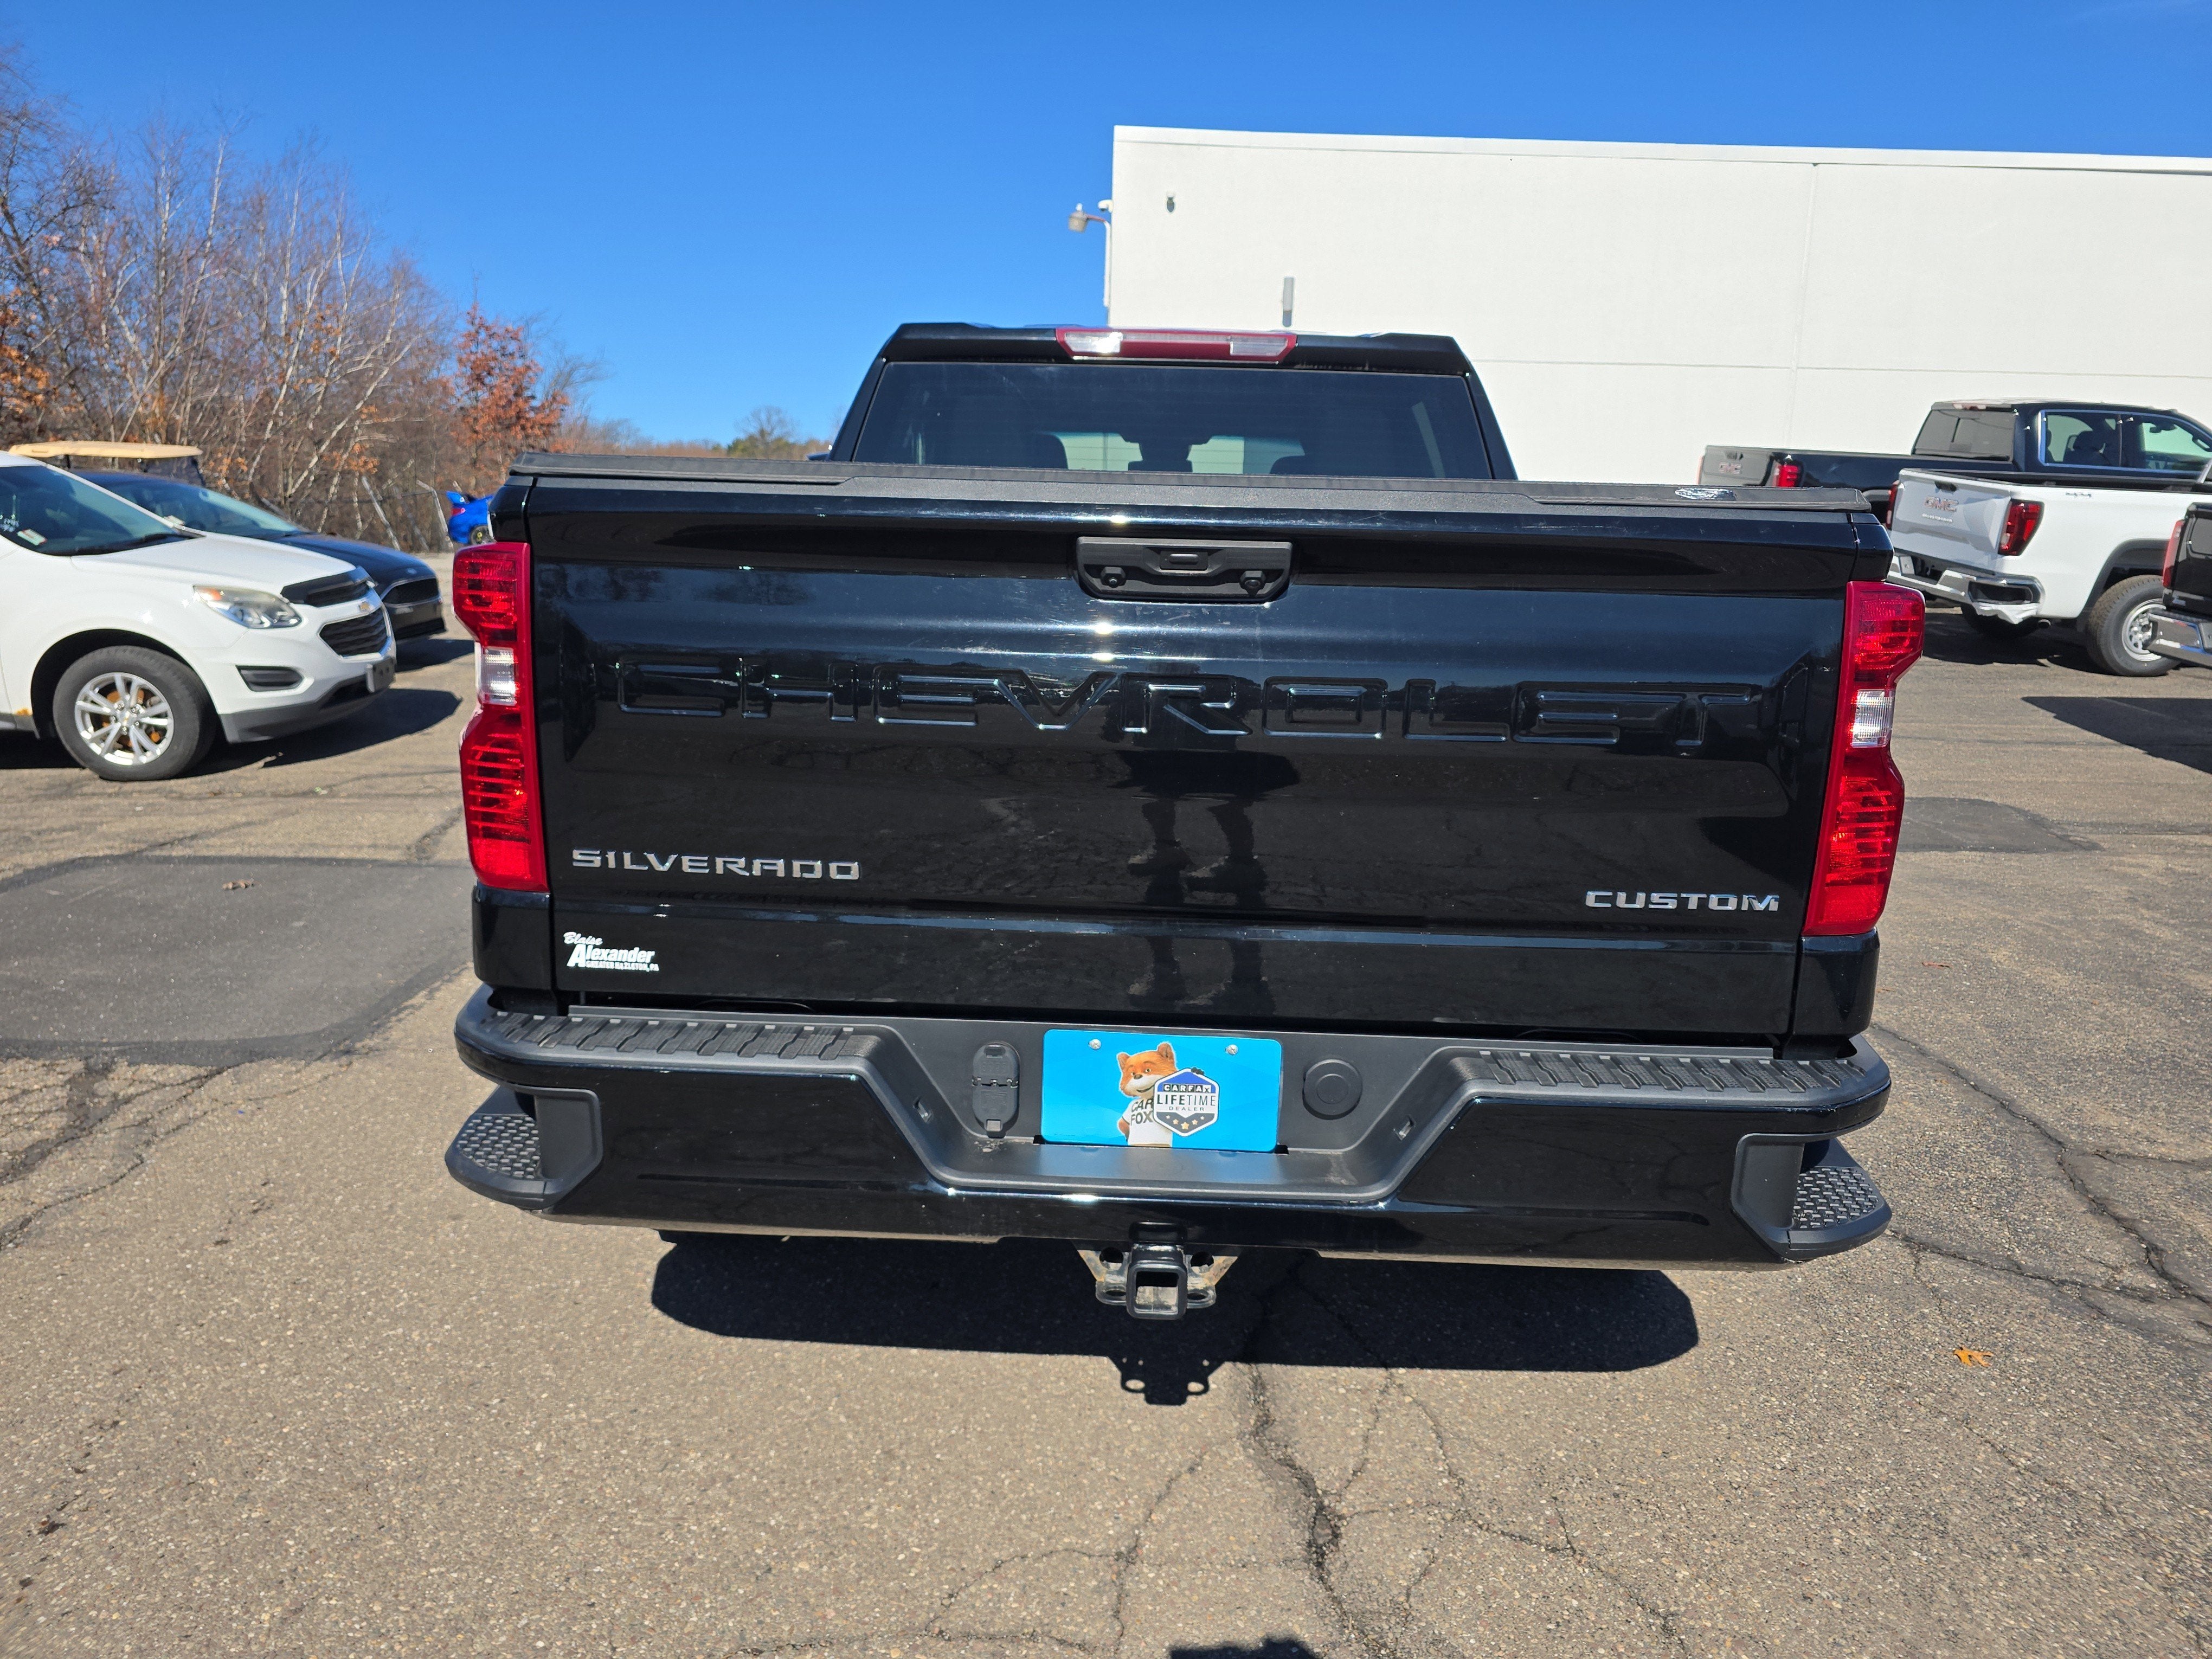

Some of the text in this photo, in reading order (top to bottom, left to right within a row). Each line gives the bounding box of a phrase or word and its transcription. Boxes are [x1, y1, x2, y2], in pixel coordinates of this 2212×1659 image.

[1925, 496, 1959, 512] GMC
[616, 654, 1758, 748] CHEVROLET
[573, 848, 860, 880] SILVERADO
[1585, 890, 1780, 911] CUSTOM
[563, 931, 603, 946] Blaise
[567, 943, 655, 967] Alexander
[586, 960, 614, 969] GREATER
[1163, 1084, 1211, 1093] CARFAX
[1157, 1094, 1216, 1106] LIFETIME
[1131, 1111, 1154, 1125] FOX
